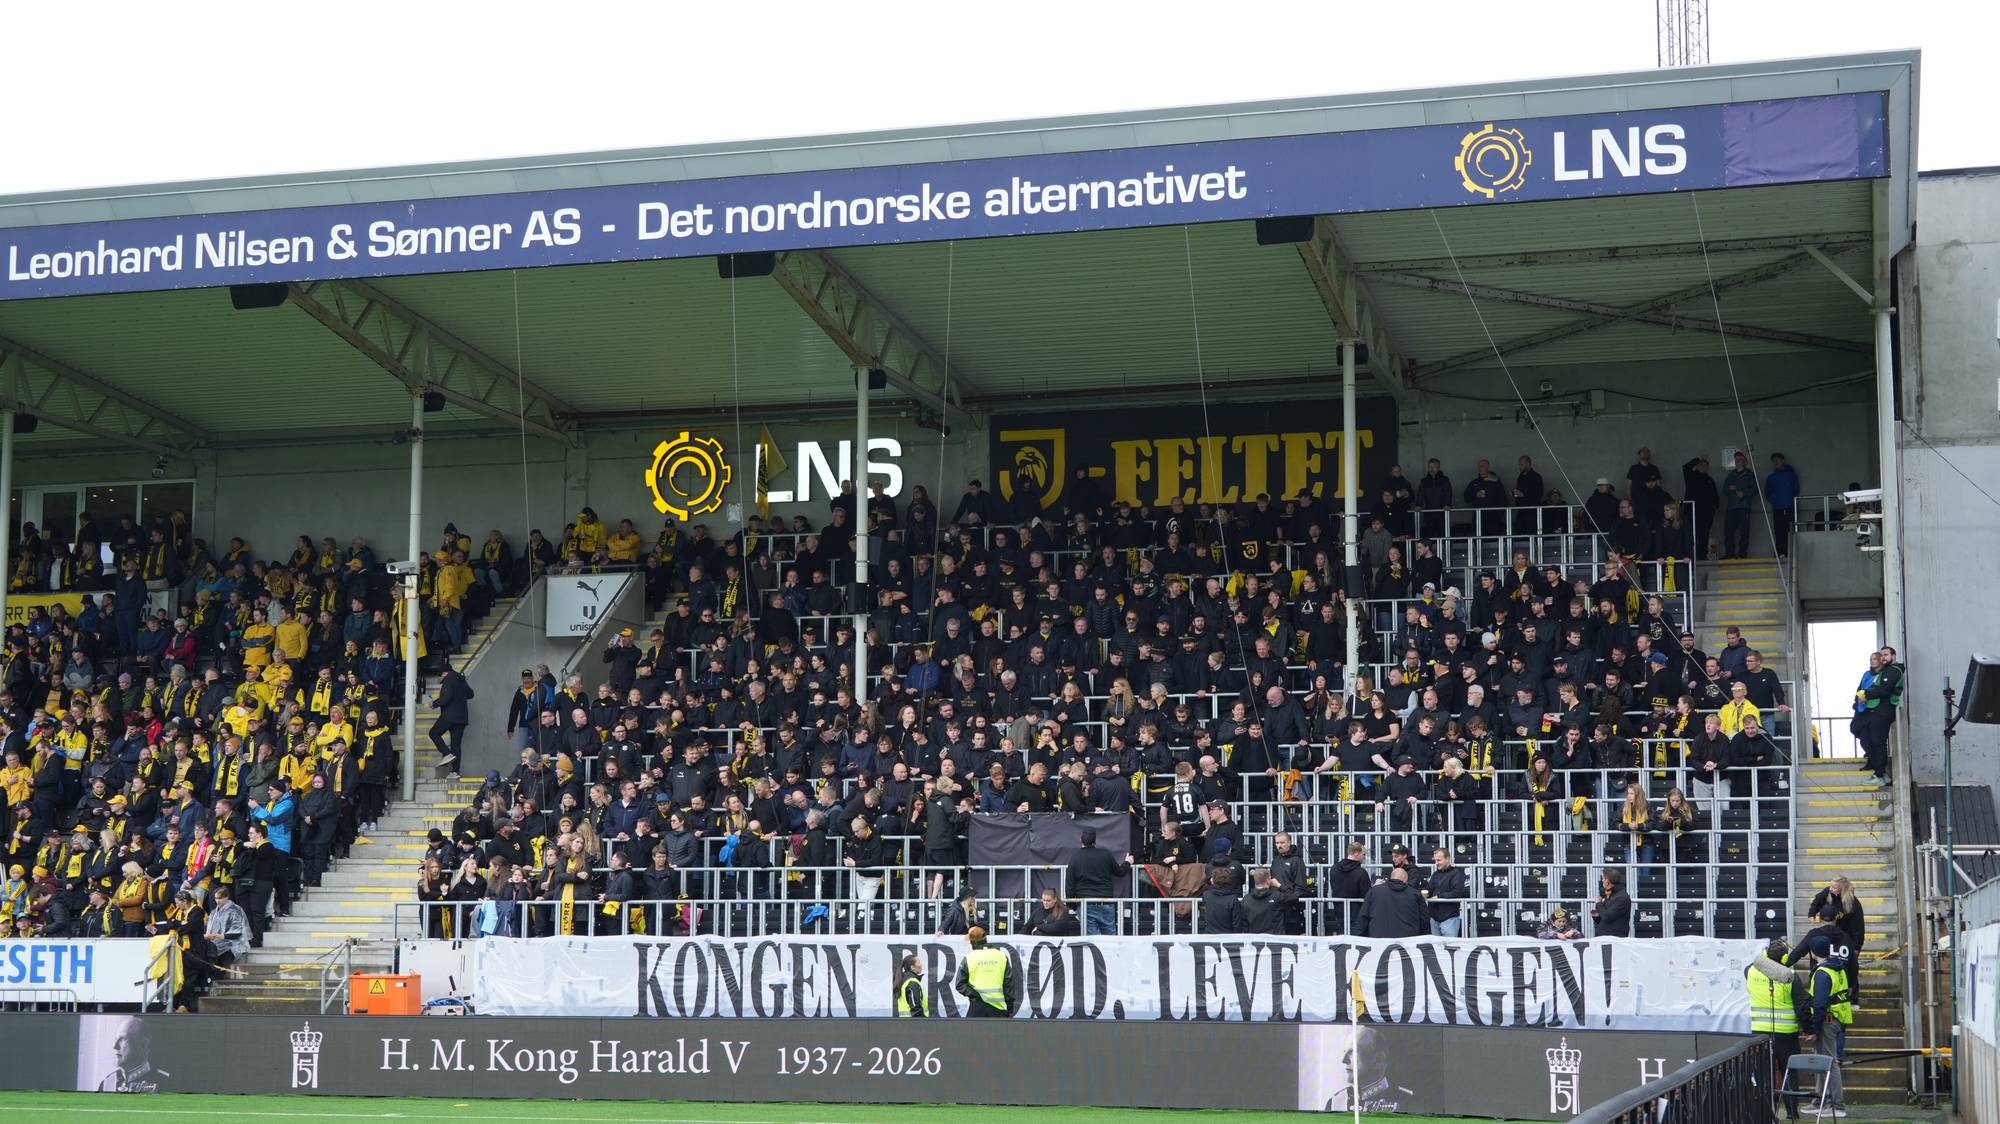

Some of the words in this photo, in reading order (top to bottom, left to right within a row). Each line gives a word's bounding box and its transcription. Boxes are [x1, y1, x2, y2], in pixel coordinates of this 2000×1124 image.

[1553, 123, 1687, 182] LNS
[8, 235, 184, 281] Leonhard
[194, 231, 314, 269] Nilsen
[326, 223, 359, 260] &
[367, 220, 513, 258] Sønner
[520, 207, 582, 249] AS
[602, 224, 616, 233] -
[638, 201, 714, 241] Det
[725, 182, 971, 235] nordnorske
[983, 164, 1248, 217] alternativet
[755, 438, 903, 503] LNS
[1173, 793, 1194, 814] 18
[1829, 943, 1850, 958] LO
[633, 940, 861, 1019] KONGEN
[1153, 941, 1303, 1022] LEVE
[1329, 942, 1612, 1028] KONGEN!
[380, 1038, 420, 1071] H.
[429, 1038, 475, 1072] M.
[485, 1039, 579, 1085] Kong
[588, 1037, 711, 1074] Harald
[719, 1040, 751, 1075] V
